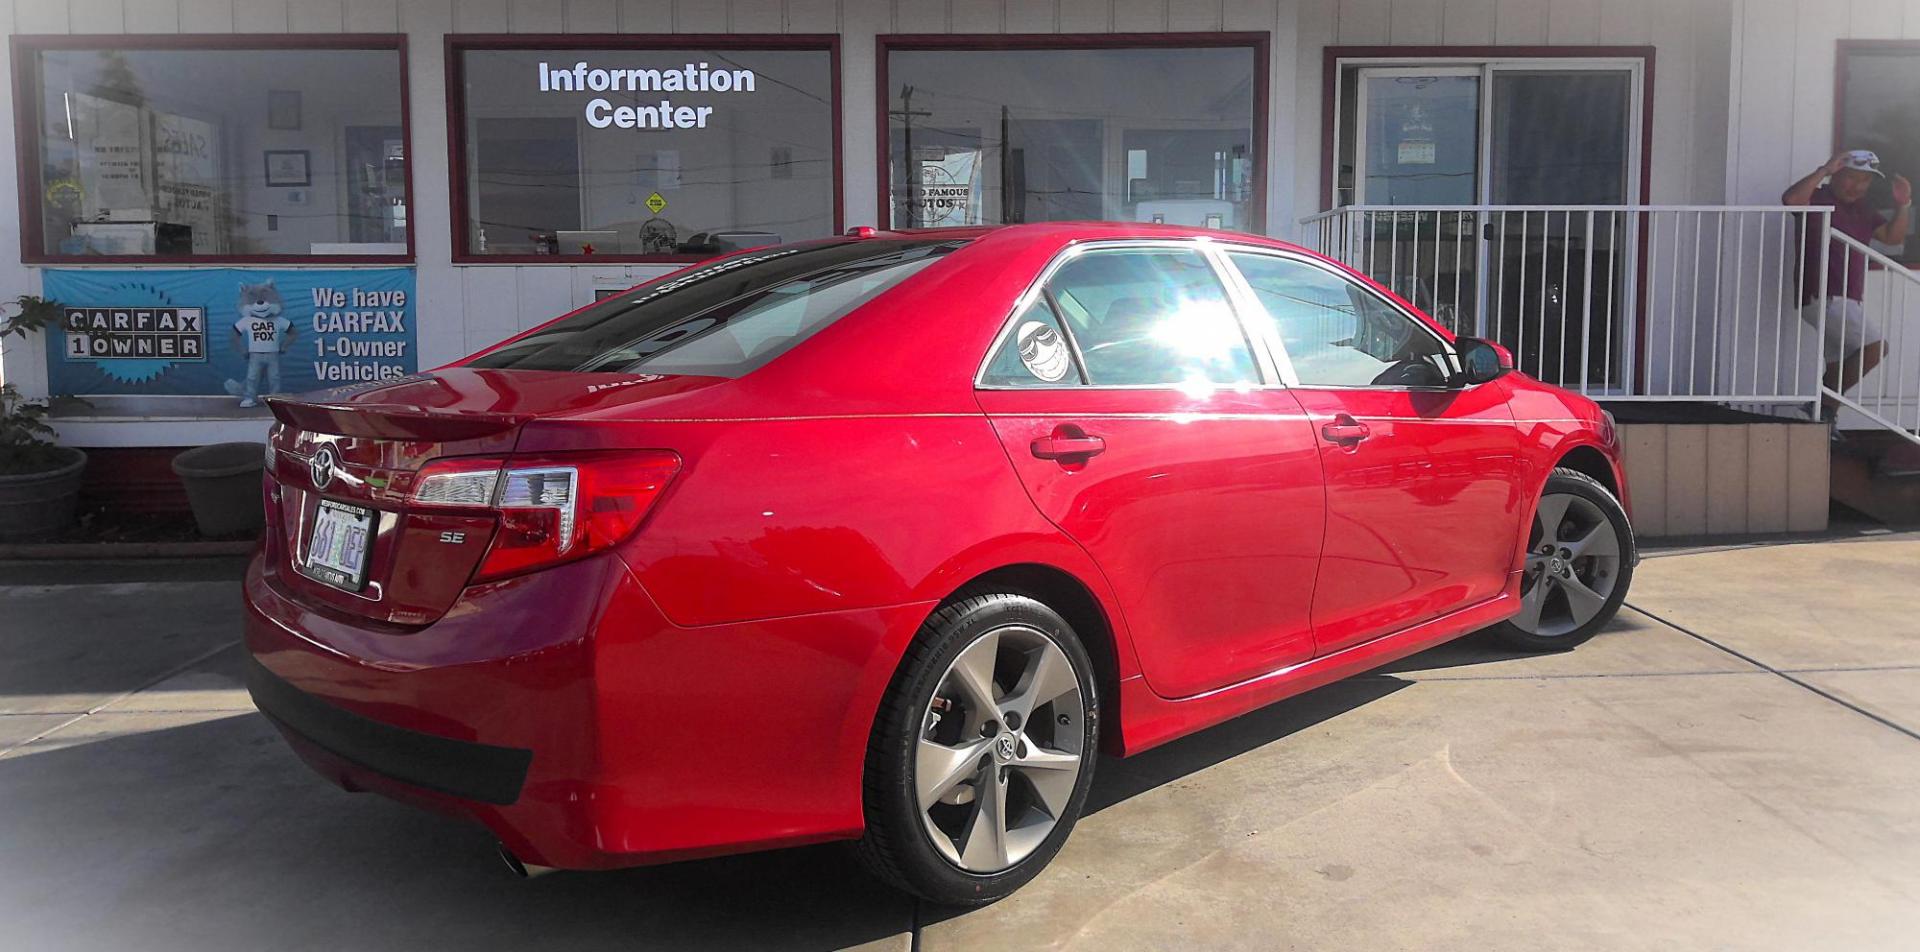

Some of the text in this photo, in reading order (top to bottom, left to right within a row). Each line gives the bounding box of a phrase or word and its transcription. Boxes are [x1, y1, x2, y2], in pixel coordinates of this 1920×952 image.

[539, 61, 755, 92] Information
[585, 99, 712, 129] Center
[929, 188, 969, 197] FAMOUS
[919, 198, 954, 208] UTOS
[312, 287, 405, 308] We have
[69, 311, 201, 332] CARFAX
[251, 322, 275, 332] CAR
[313, 311, 405, 333] CARFAX
[253, 332, 275, 343] FOX
[315, 338, 405, 357] 1-Owner
[316, 361, 405, 381] Vehicles
[439, 531, 465, 544] SE
